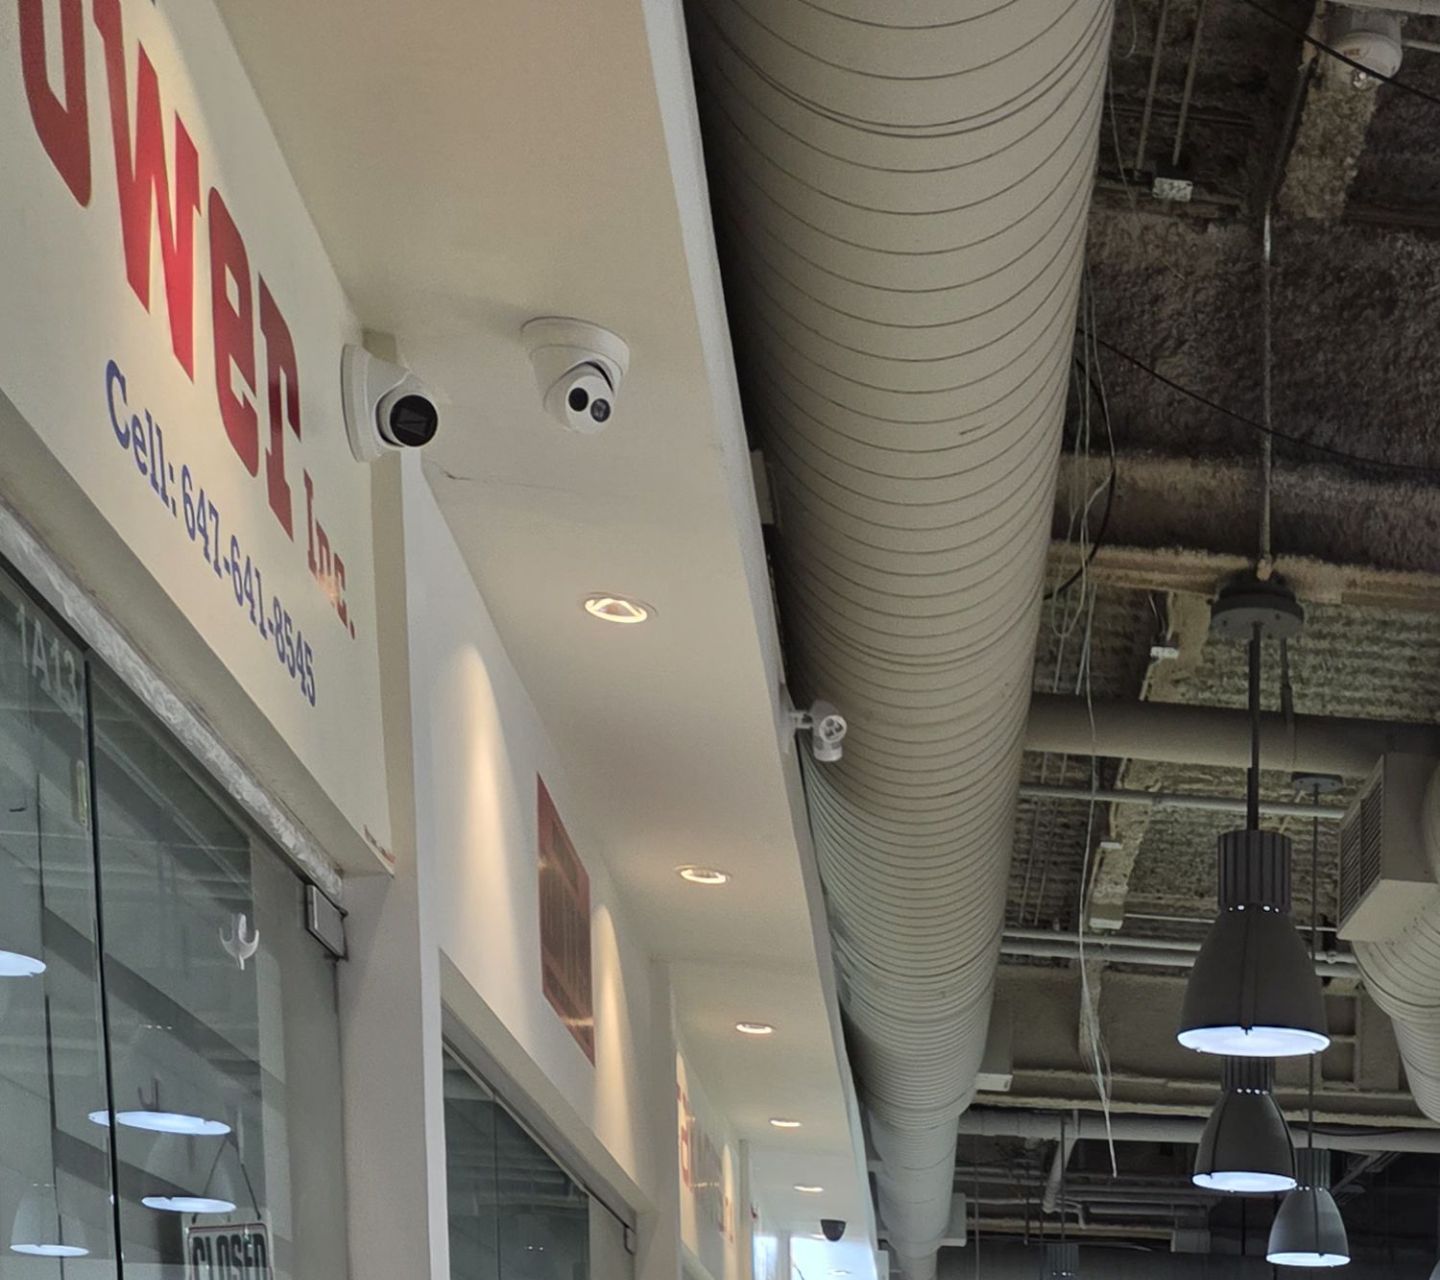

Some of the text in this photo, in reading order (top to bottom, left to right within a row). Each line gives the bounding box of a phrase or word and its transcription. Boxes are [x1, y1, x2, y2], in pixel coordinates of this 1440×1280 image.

[105, 358, 316, 709] Cell: 647-641-8545
[303, 467, 356, 640] Inc.
